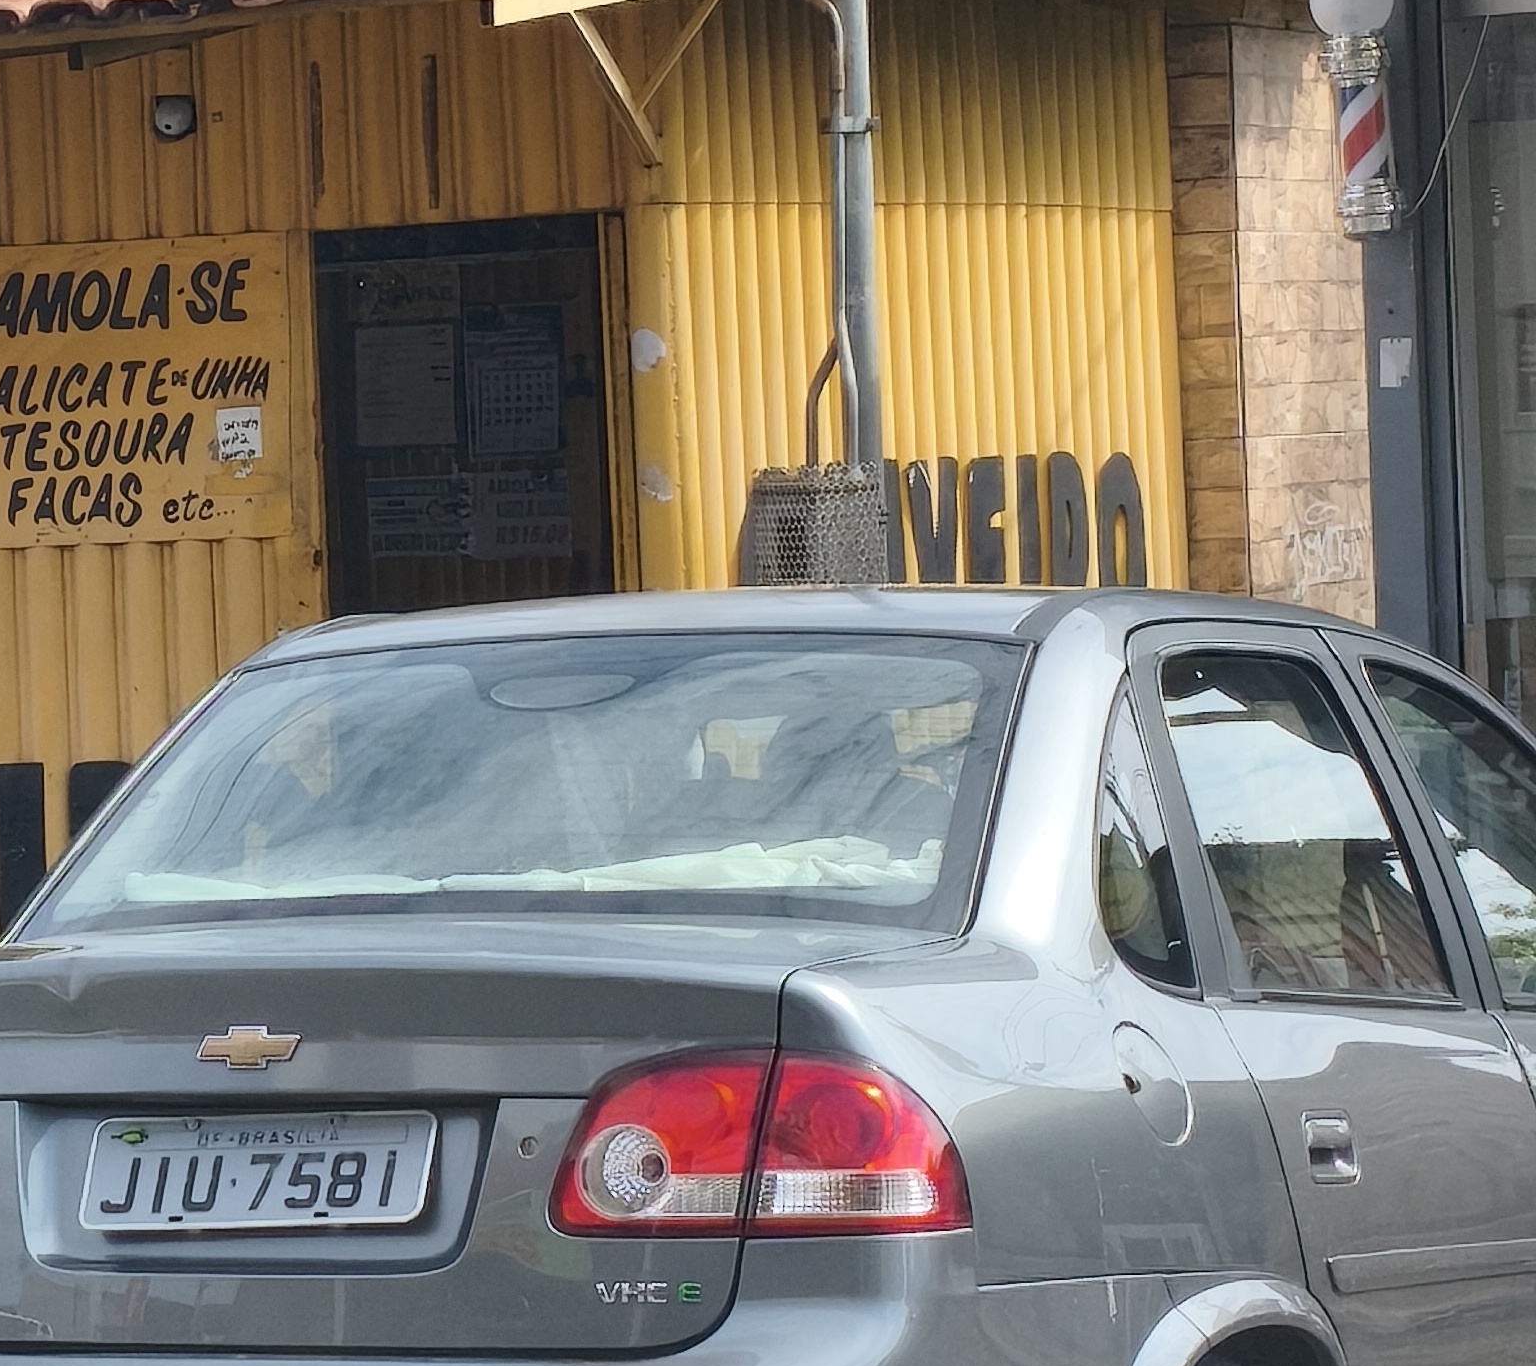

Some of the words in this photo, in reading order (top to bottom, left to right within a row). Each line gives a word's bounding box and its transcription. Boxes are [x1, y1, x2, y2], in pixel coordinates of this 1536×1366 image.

[191, 356, 270, 401] UNHA
[0, 412, 194, 471] TESOURA
[7, 472, 143, 528] FACAS
